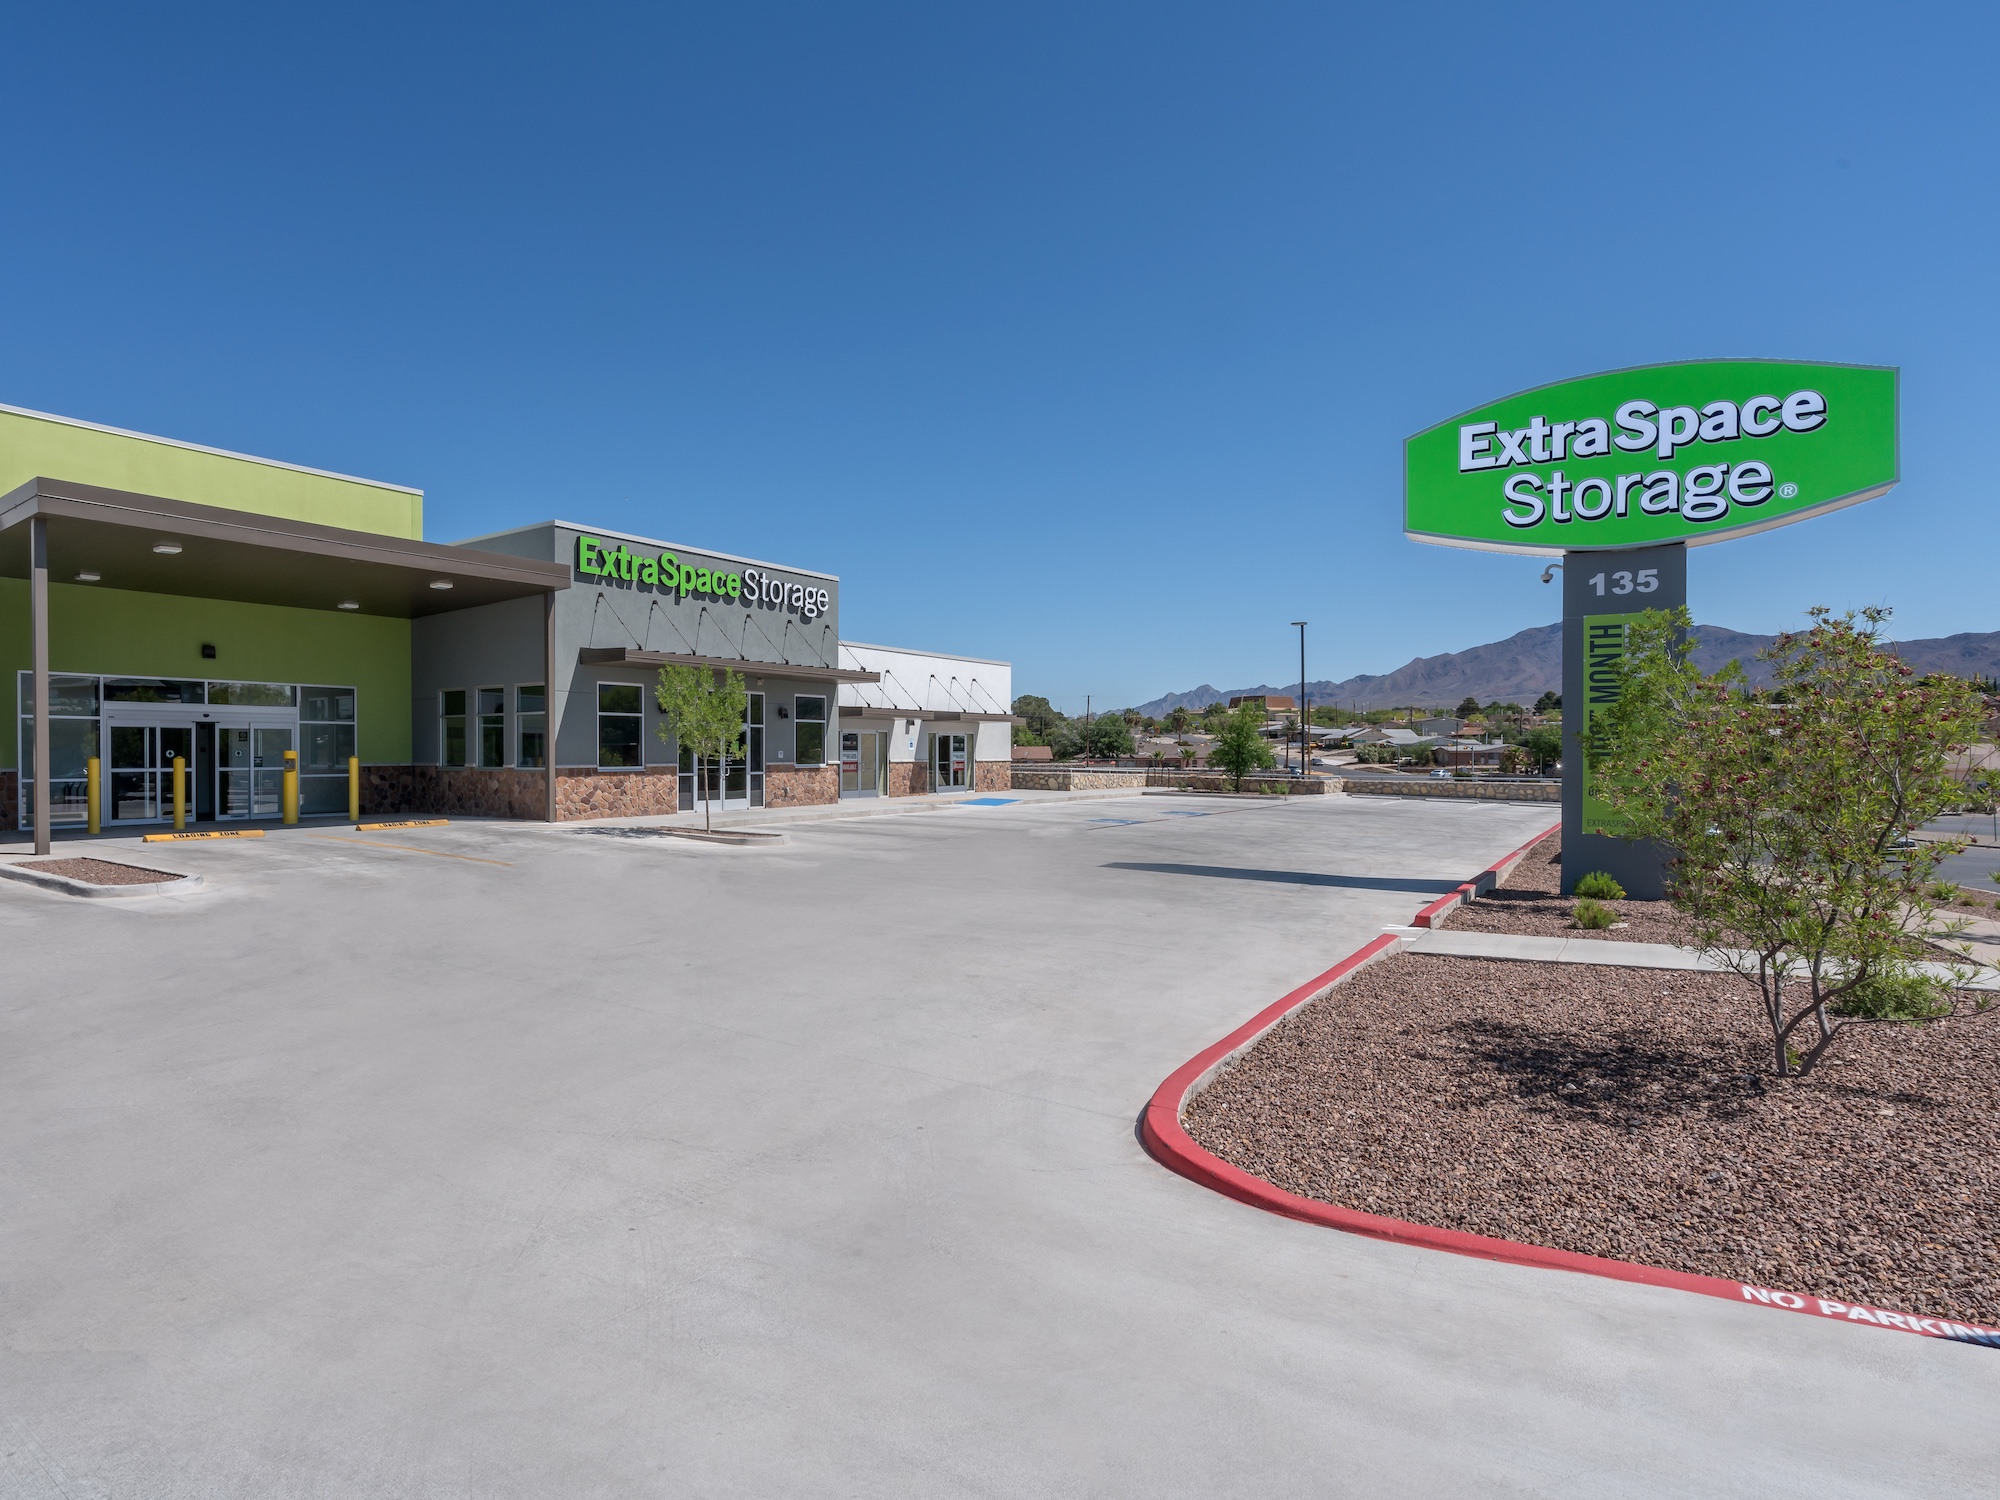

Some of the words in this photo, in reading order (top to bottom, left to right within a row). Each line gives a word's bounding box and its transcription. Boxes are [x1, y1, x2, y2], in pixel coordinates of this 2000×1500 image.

[743, 568, 829, 618] Storage
[1588, 568, 1660, 596] 135
[1589, 624, 1622, 704] MONTH
[1742, 1285, 1804, 1309] NO
